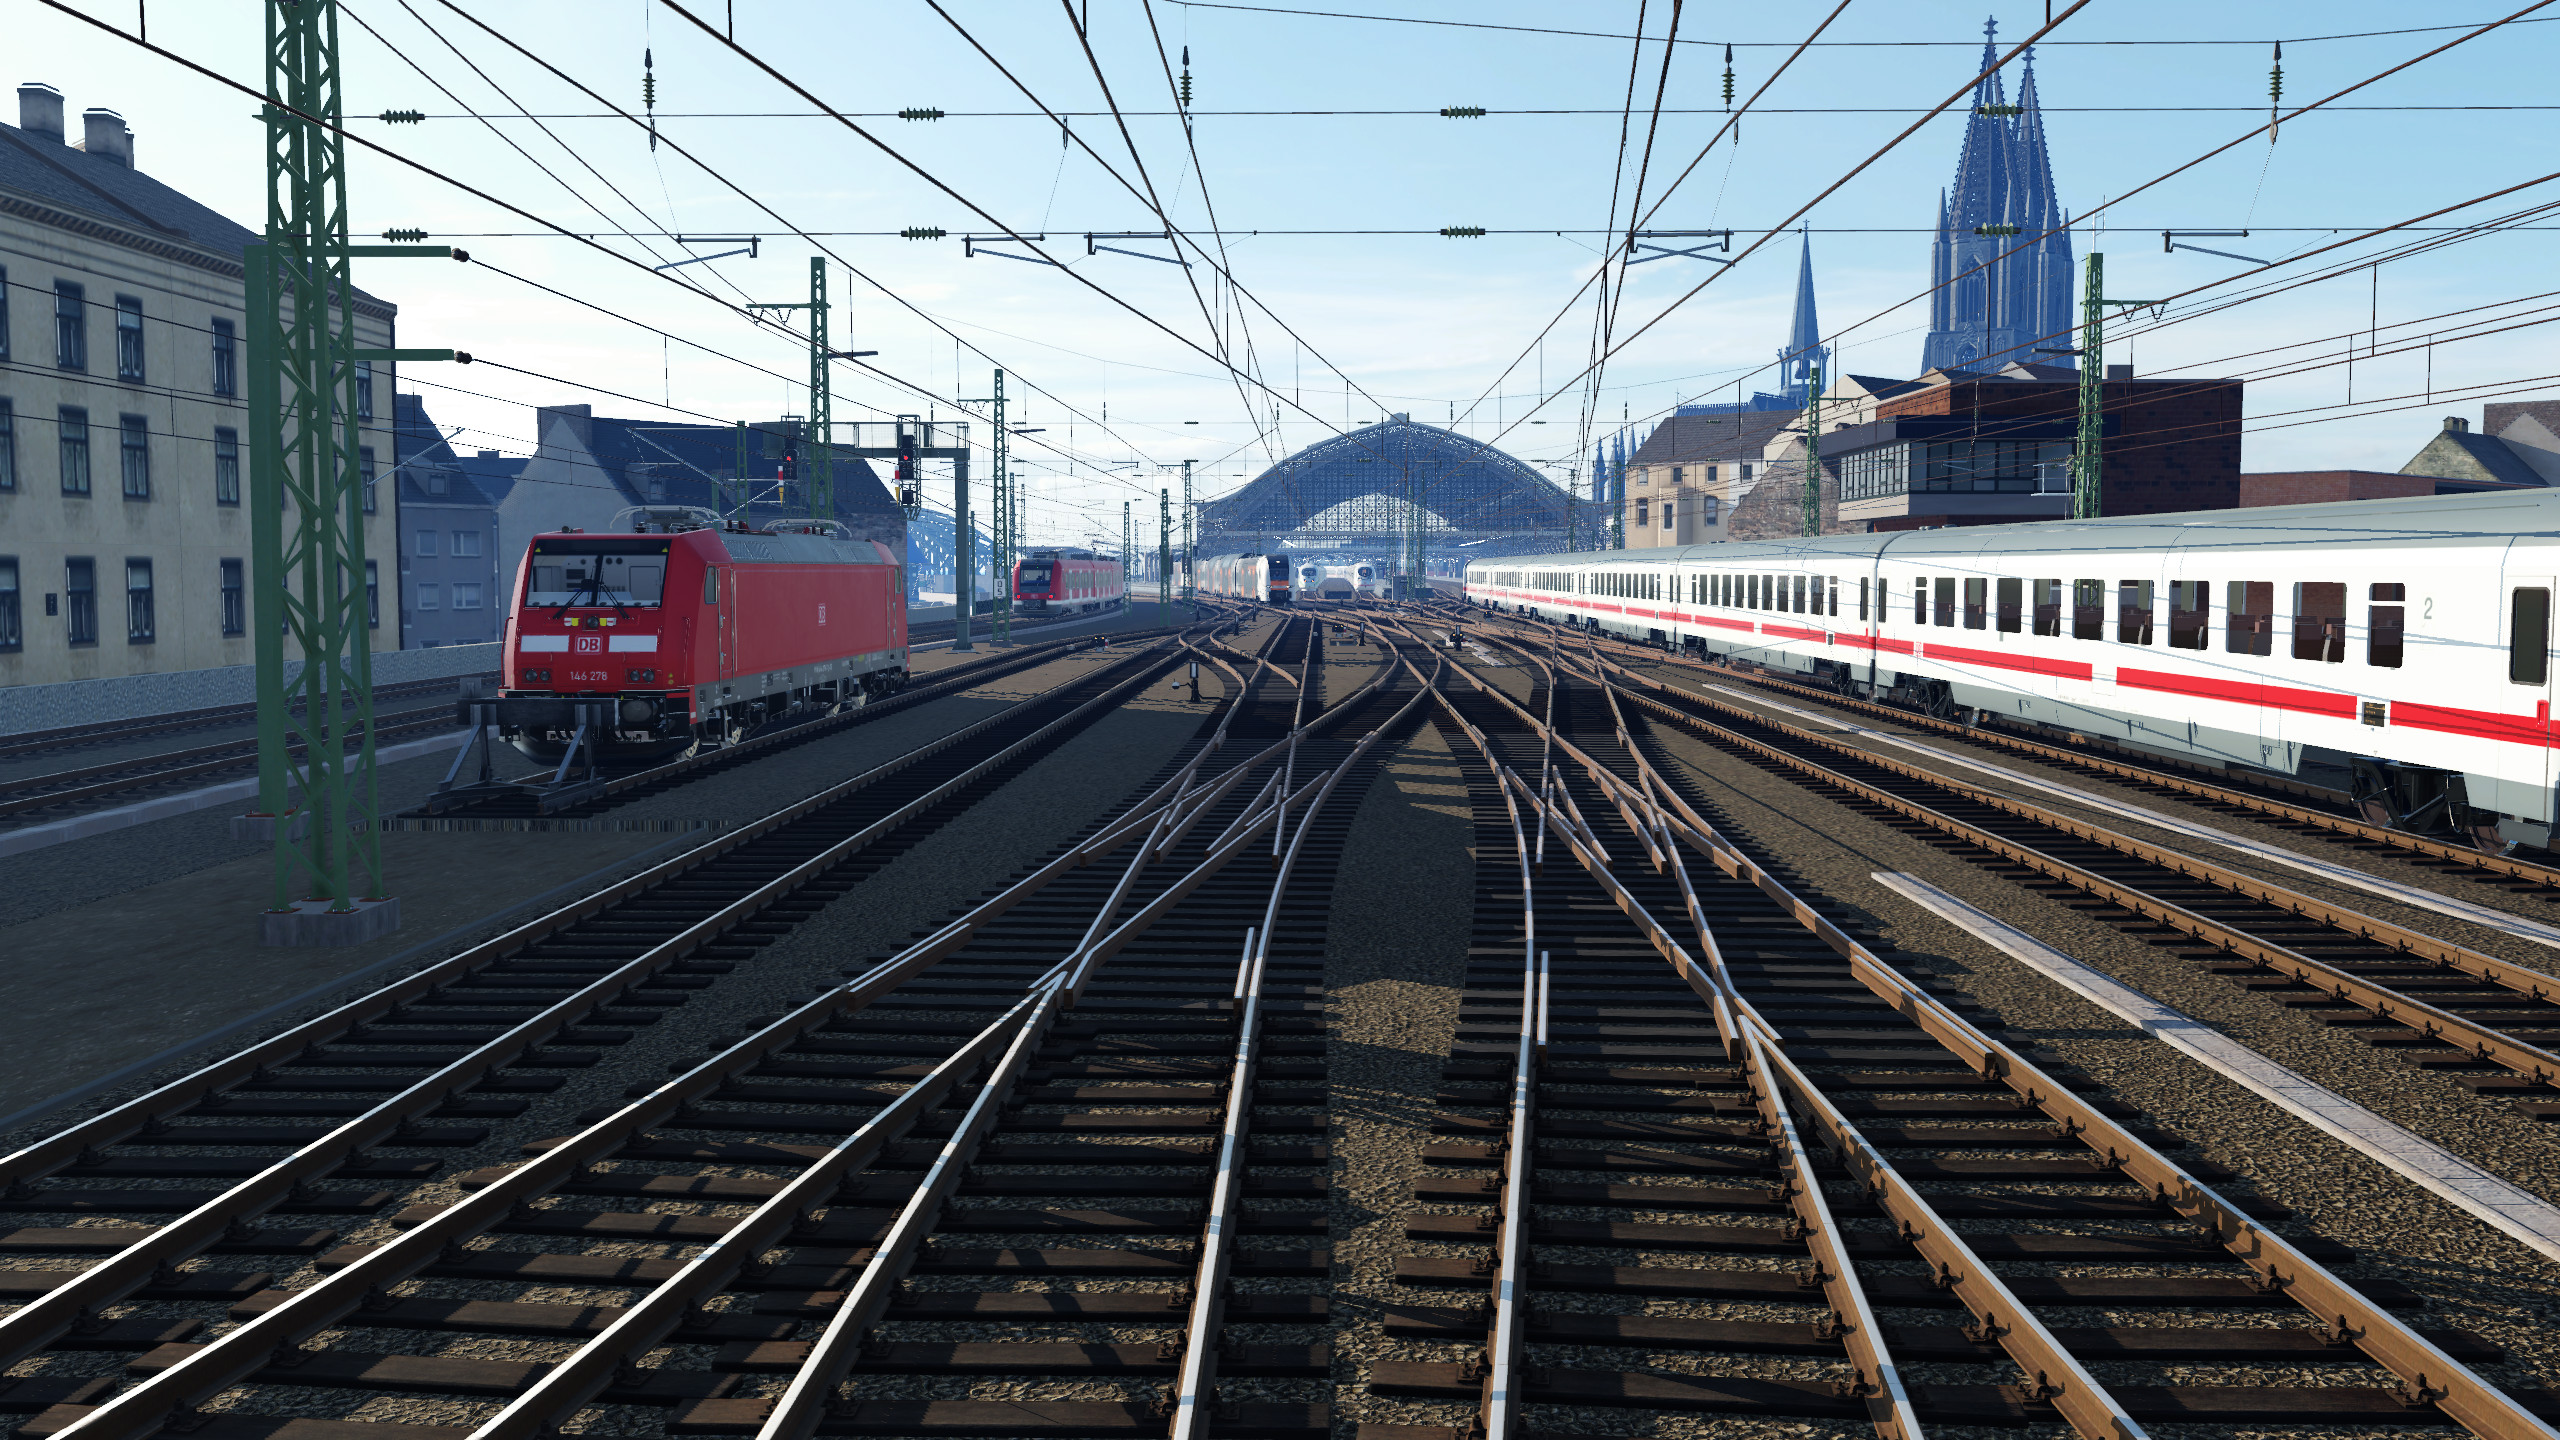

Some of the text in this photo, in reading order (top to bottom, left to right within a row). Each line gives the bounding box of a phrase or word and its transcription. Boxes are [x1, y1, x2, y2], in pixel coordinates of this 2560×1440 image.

[997, 588, 1003, 596] 5
[2424, 597, 2433, 620] 2
[579, 638, 599, 651] DB
[570, 671, 608, 681] 146 278
